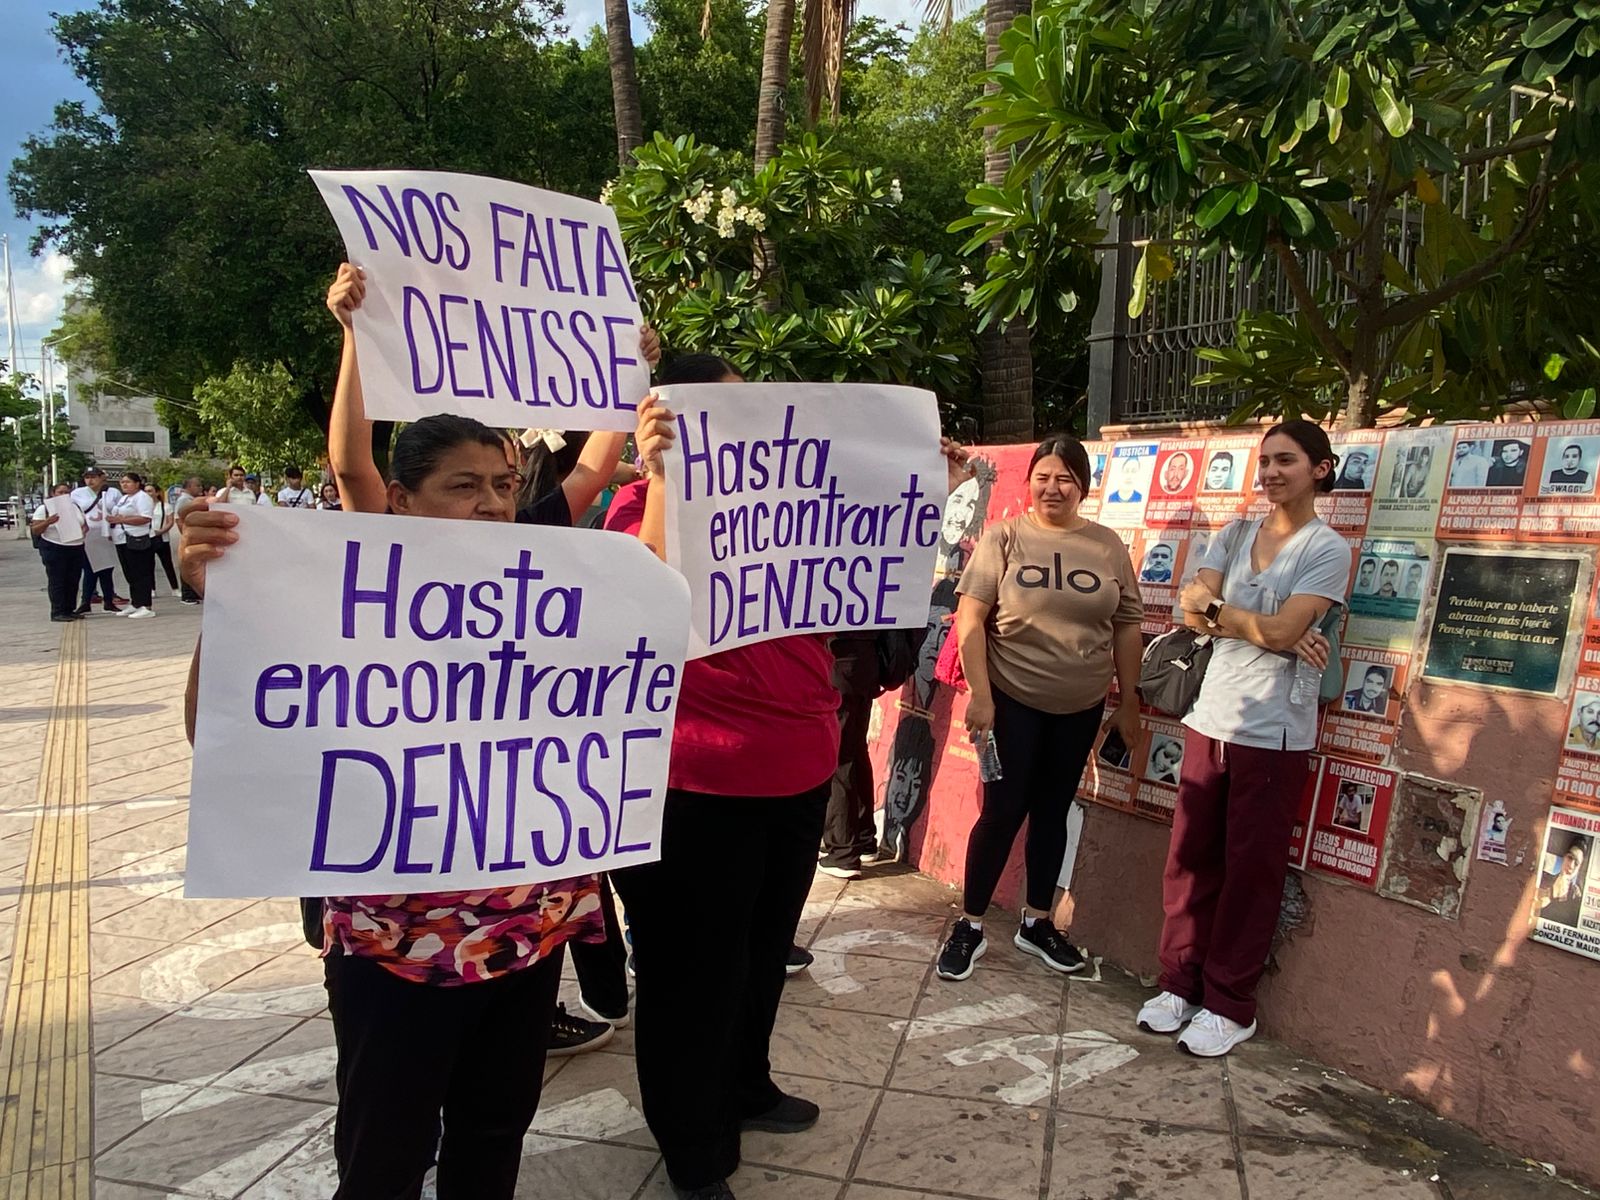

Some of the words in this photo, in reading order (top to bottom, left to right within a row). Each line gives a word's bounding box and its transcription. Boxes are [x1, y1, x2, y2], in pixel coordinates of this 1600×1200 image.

[342, 186, 470, 270] NOS
[491, 203, 636, 302] FALTA
[404, 287, 637, 411] DENISSE
[1458, 424, 1534, 438] DESAPARECIDO
[678, 406, 831, 500] Hasta
[1119, 446, 1150, 458] JUSTICIA
[1447, 496, 1482, 505] ALFONSO
[1482, 495, 1518, 505] ALBERTO
[711, 474, 940, 560] encontrarte
[1440, 517, 1452, 528] 01
[1452, 517, 1472, 528] 800
[1473, 517, 1517, 529] 6703600
[1016, 552, 1101, 593] alo
[342, 541, 582, 640] Hasta
[710, 556, 905, 645] DENISSE
[1448, 611, 1497, 624] abrazado
[1484, 601, 1503, 611] por
[1503, 602, 1517, 611] no
[1518, 601, 1559, 614] haberte
[1465, 627, 1483, 639] que
[1483, 627, 1493, 637] te
[1532, 635, 1542, 644] a
[1542, 635, 1559, 645] ver
[1341, 647, 1408, 666] DESAPARECIDO
[255, 637, 676, 728] encontrarte
[1322, 732, 1334, 744] 01
[1333, 734, 1351, 748] 800
[1329, 762, 1392, 788] DESAPARECIDO
[1556, 777, 1569, 791] 01
[1571, 780, 1593, 797] 800
[310, 728, 662, 873] DENISSE
[1551, 811, 1586, 830] AYUDANOS
[1586, 820, 1593, 831] A
[1315, 831, 1341, 848] JESUS
[1343, 838, 1378, 858] MANUEL
[1312, 851, 1322, 863] 01
[1322, 854, 1337, 867] 800
[1337, 859, 1372, 877] 6703600
[1533, 928, 1575, 948] GONZALEZ
[1543, 922, 1561, 934] LUIS
